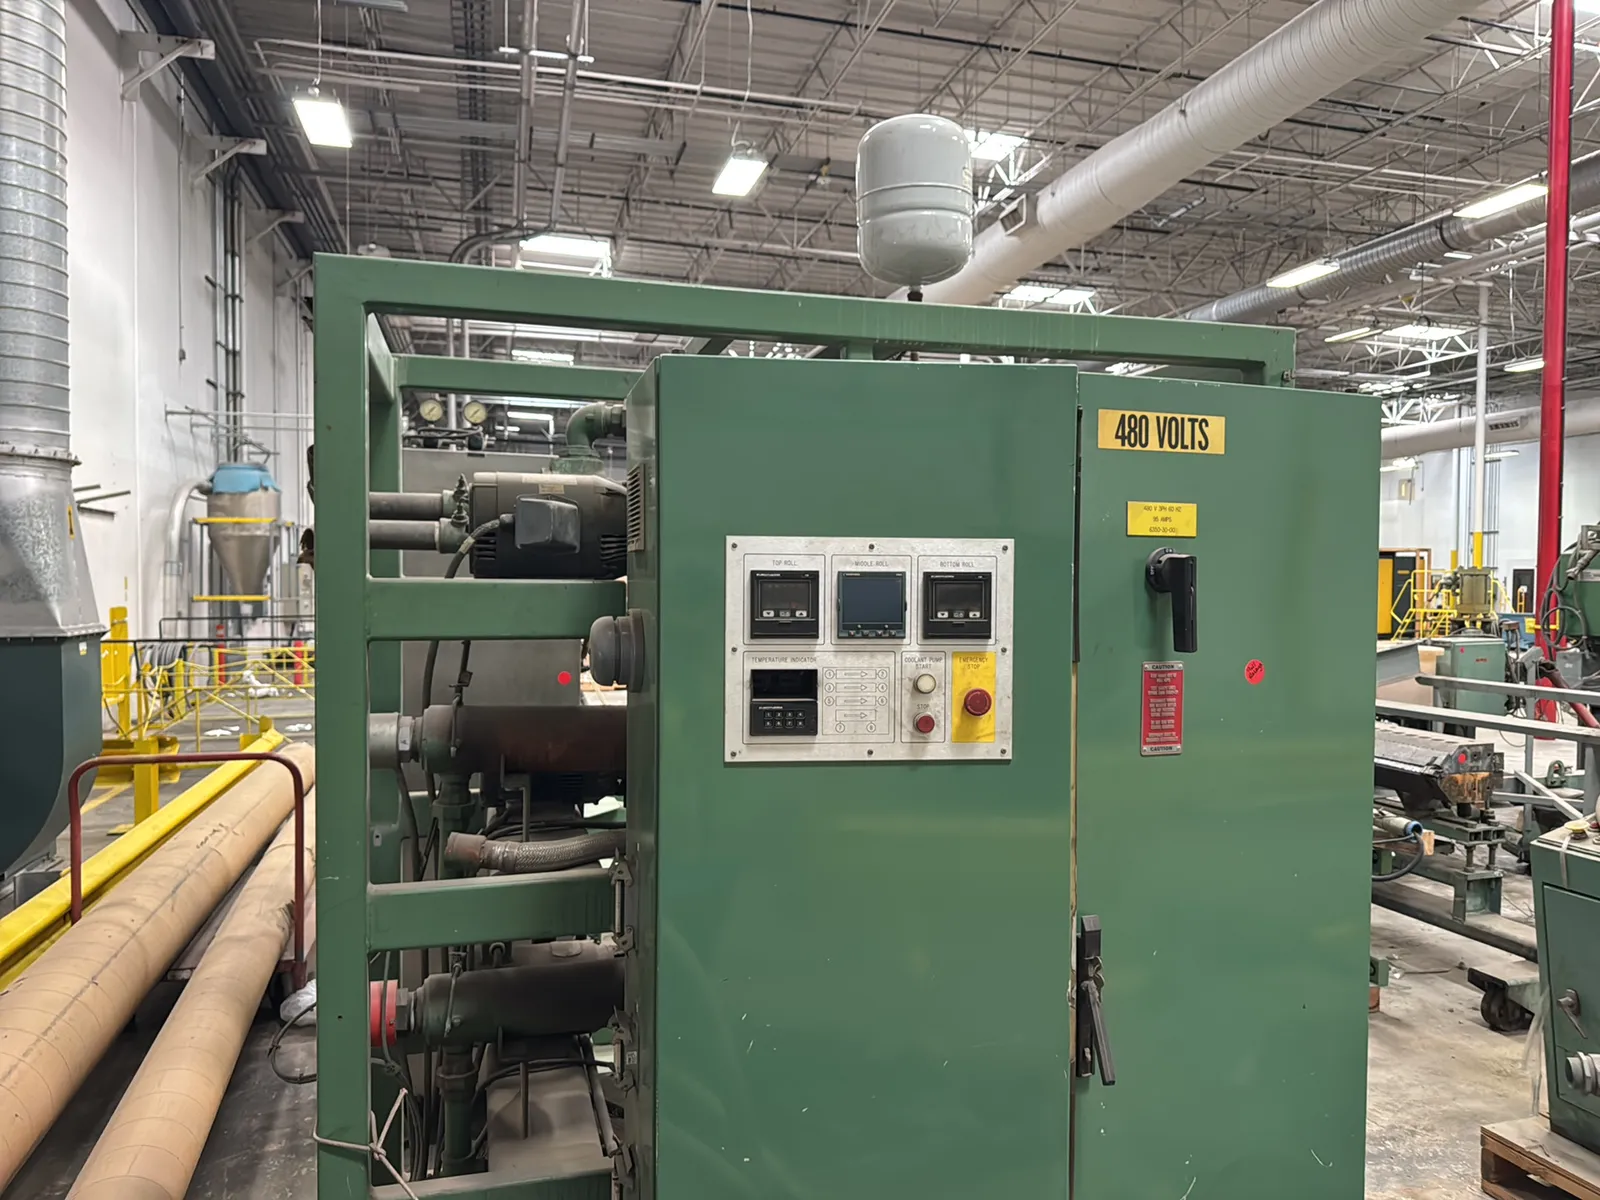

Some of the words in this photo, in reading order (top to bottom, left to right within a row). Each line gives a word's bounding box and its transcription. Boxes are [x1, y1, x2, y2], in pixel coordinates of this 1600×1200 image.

[1114, 413, 1149, 449] 480
[1156, 415, 1209, 451] VOLTS
[772, 559, 783, 567] TOP
[783, 559, 797, 567] ROLL
